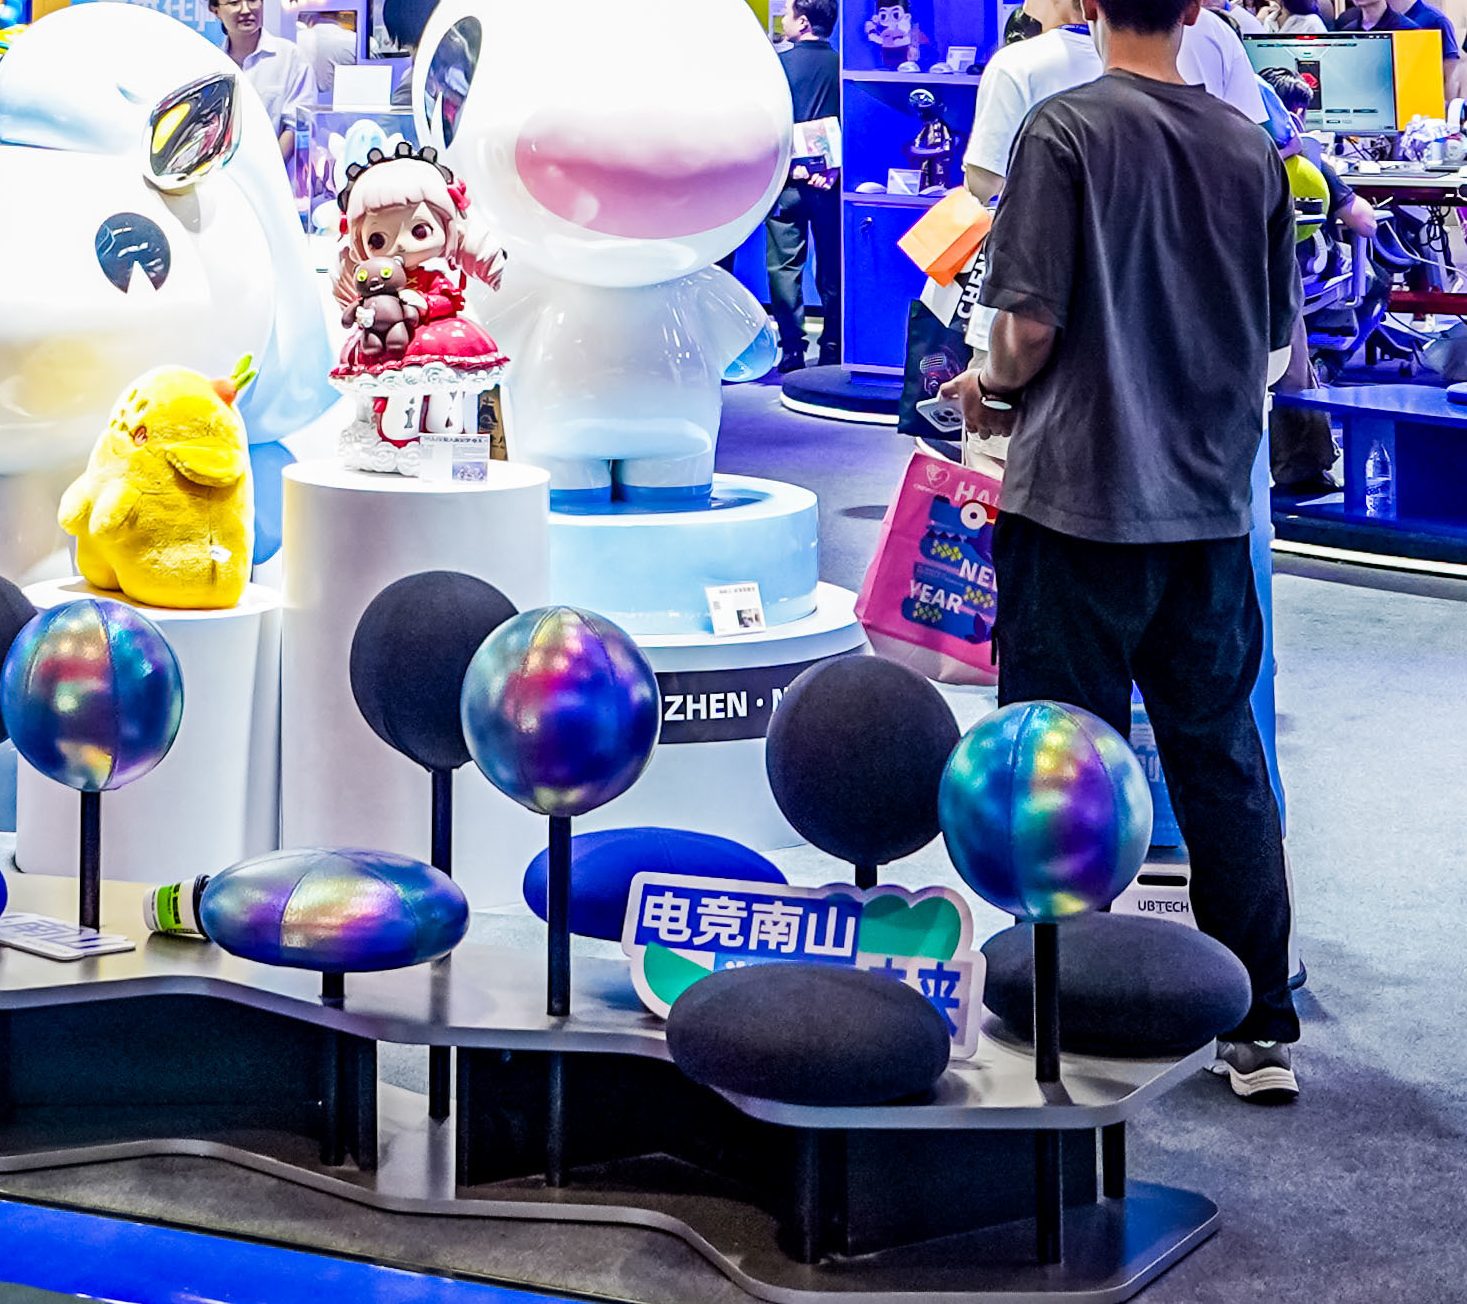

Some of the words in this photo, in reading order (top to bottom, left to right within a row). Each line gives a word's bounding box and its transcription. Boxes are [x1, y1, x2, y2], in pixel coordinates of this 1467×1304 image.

[909, 578, 964, 616] YEAR
[663, 690, 748, 722] ZHEN
[641, 890, 857, 958] 电竞南山
[1137, 899, 1190, 914] UBTECH
